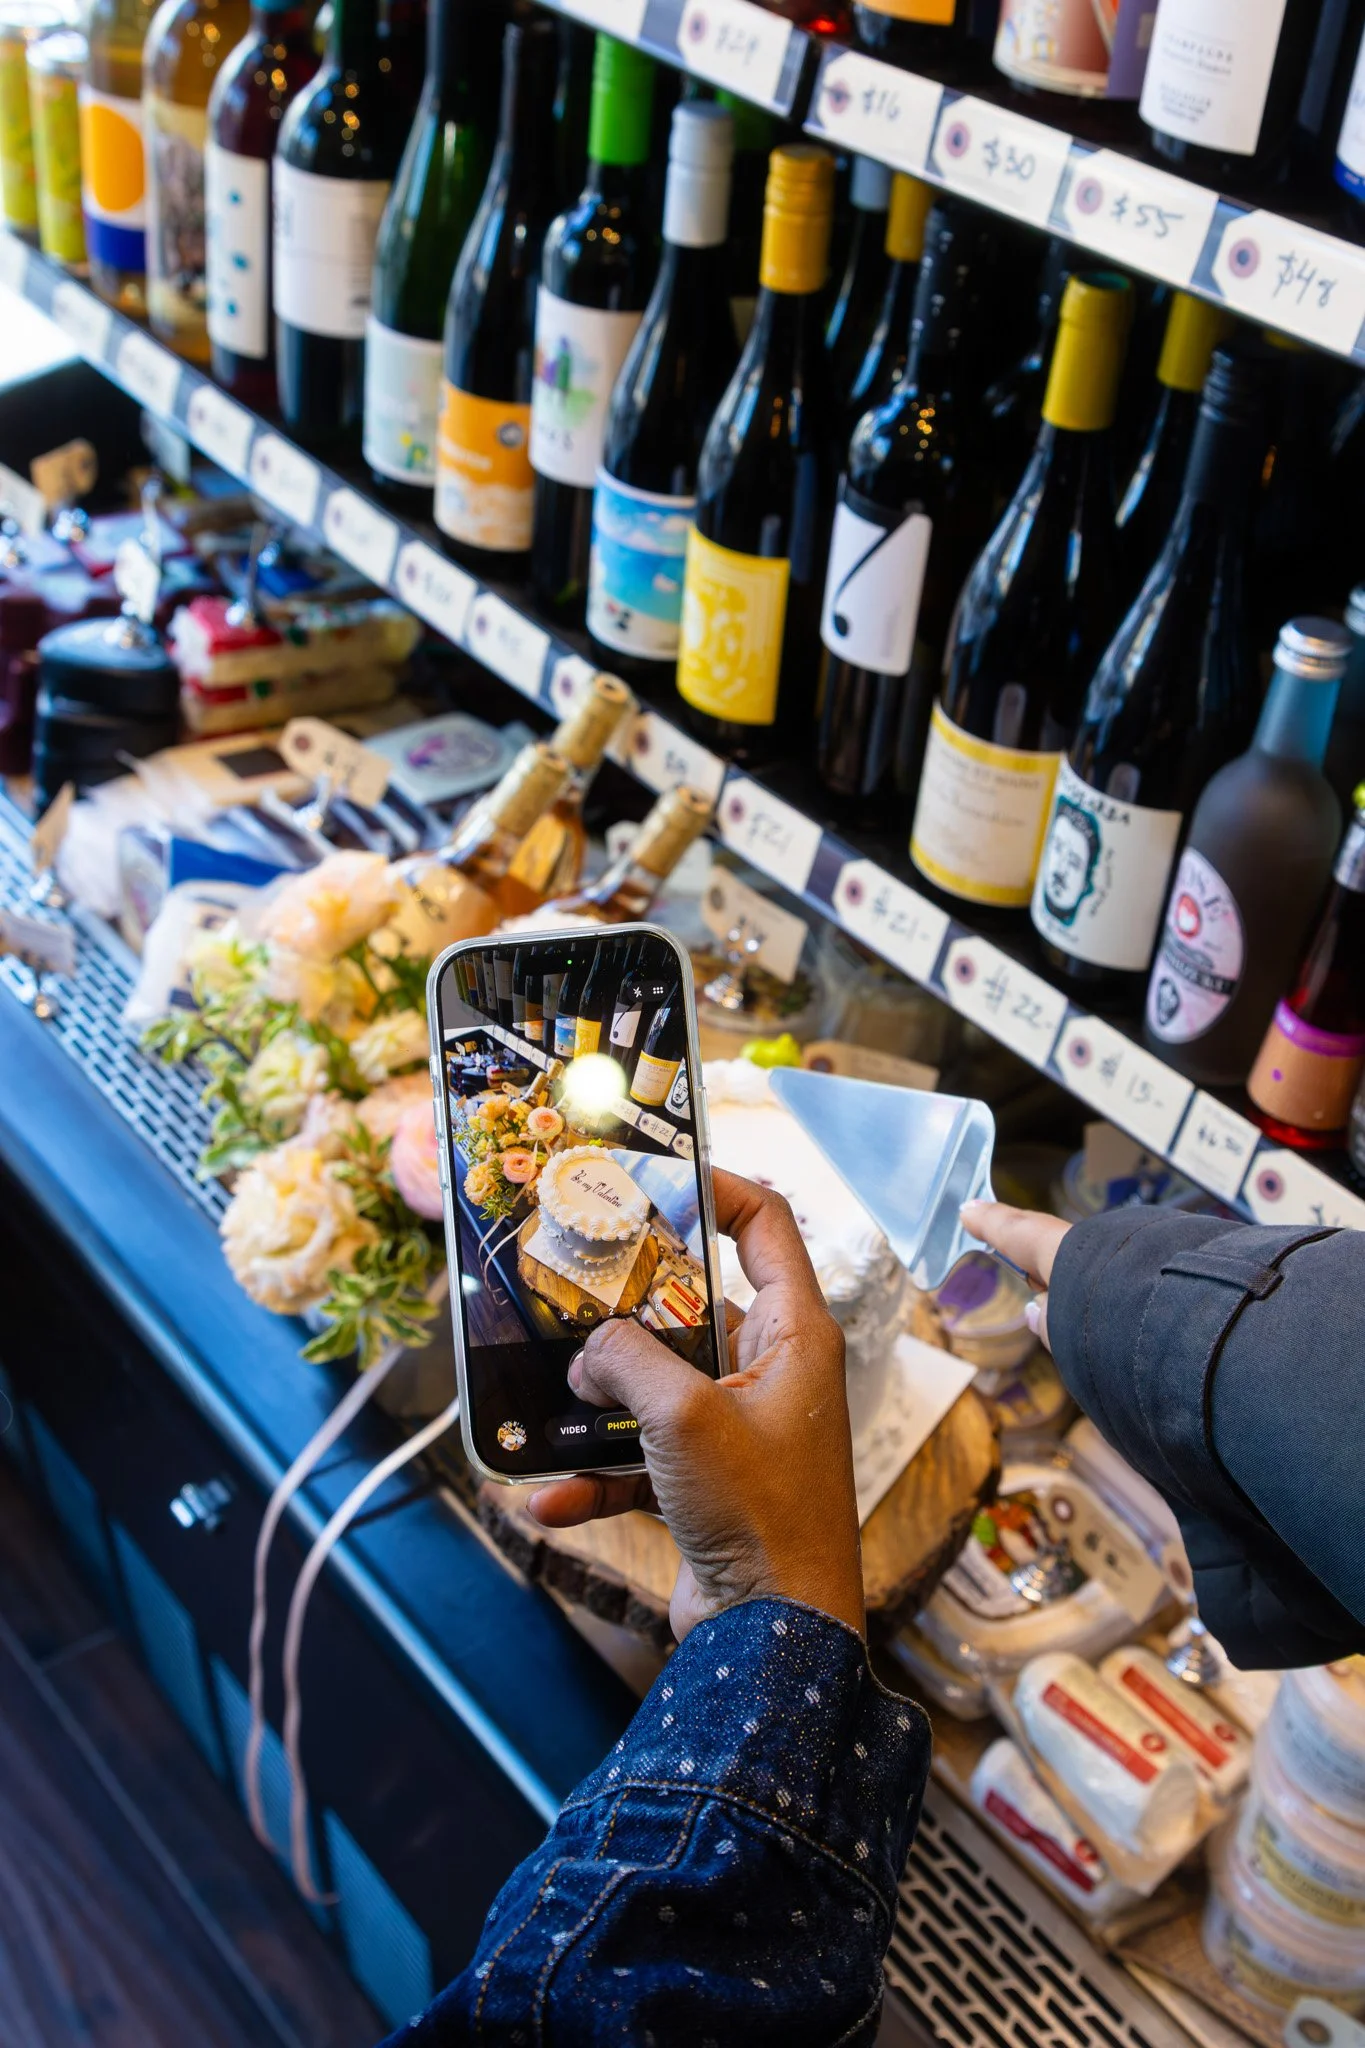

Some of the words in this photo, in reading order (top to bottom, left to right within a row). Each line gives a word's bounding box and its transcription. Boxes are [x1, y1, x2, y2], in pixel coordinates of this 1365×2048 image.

[981, 134, 1037, 182] $30
[1109, 193, 1185, 239] $55
[1273, 250, 1338, 308] $48
[592, 1182, 622, 1208] Valentine
[583, 1310, 593, 1318] 1x
[608, 1308, 614, 1316] 2
[631, 1305, 638, 1314] 4
[655, 1303, 661, 1311] 8
[560, 1424, 587, 1435] VIDEO
[607, 1420, 637, 1431] PHOTO
